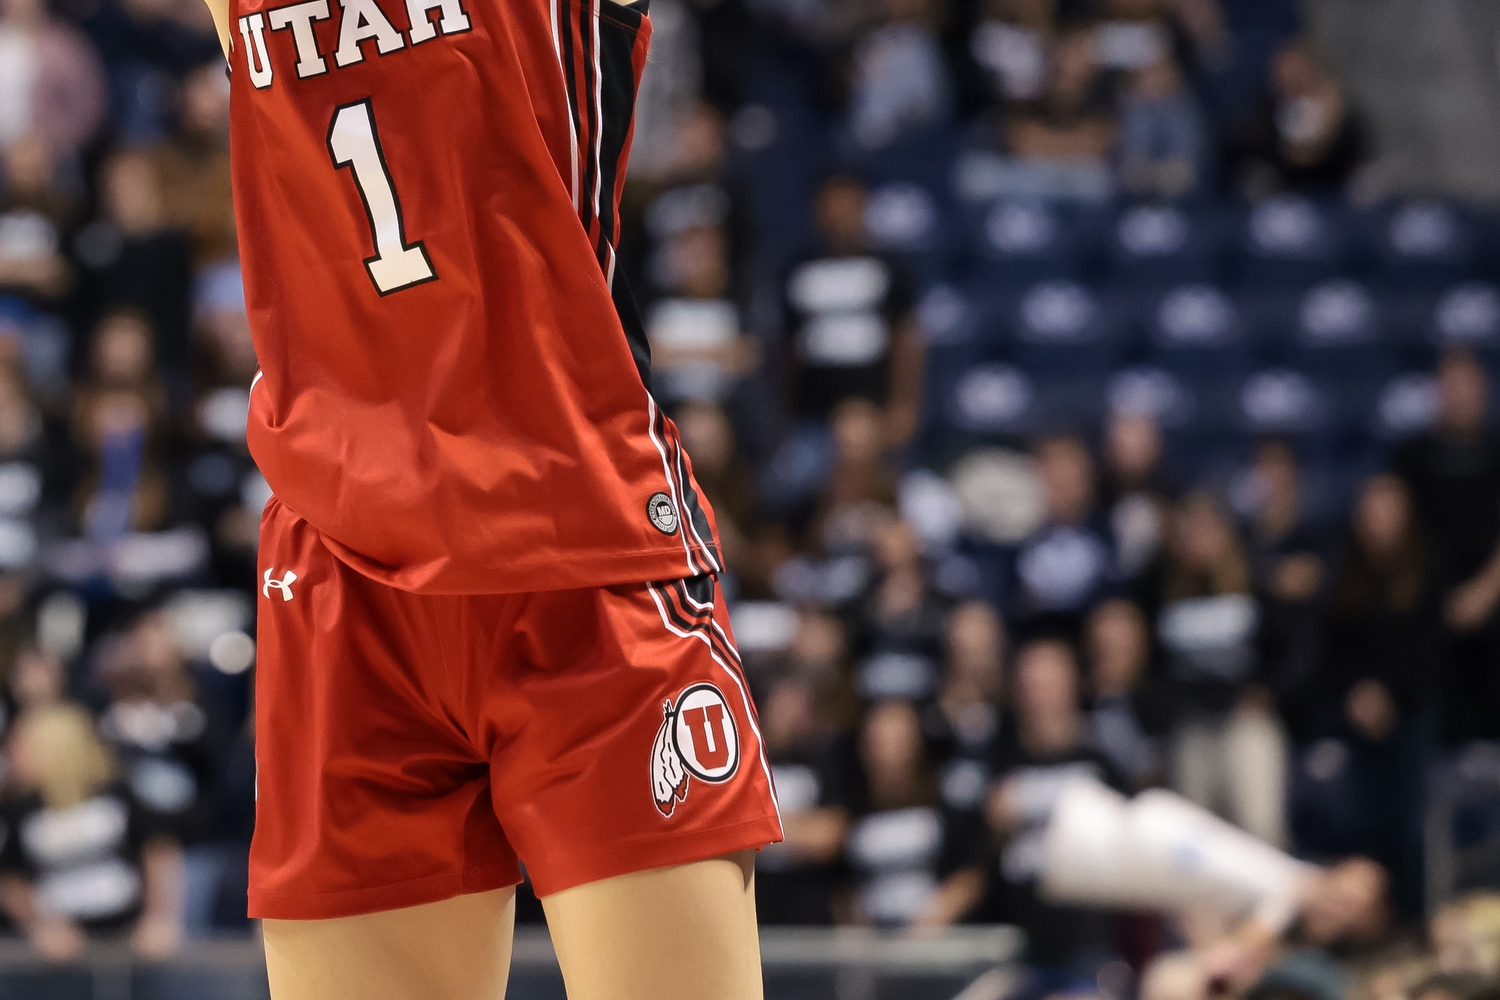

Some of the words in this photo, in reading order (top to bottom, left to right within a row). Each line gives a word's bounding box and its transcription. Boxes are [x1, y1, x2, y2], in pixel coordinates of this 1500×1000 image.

[326, 97, 440, 298] 1
[656, 505, 671, 517] MD
[682, 703, 730, 771] U
